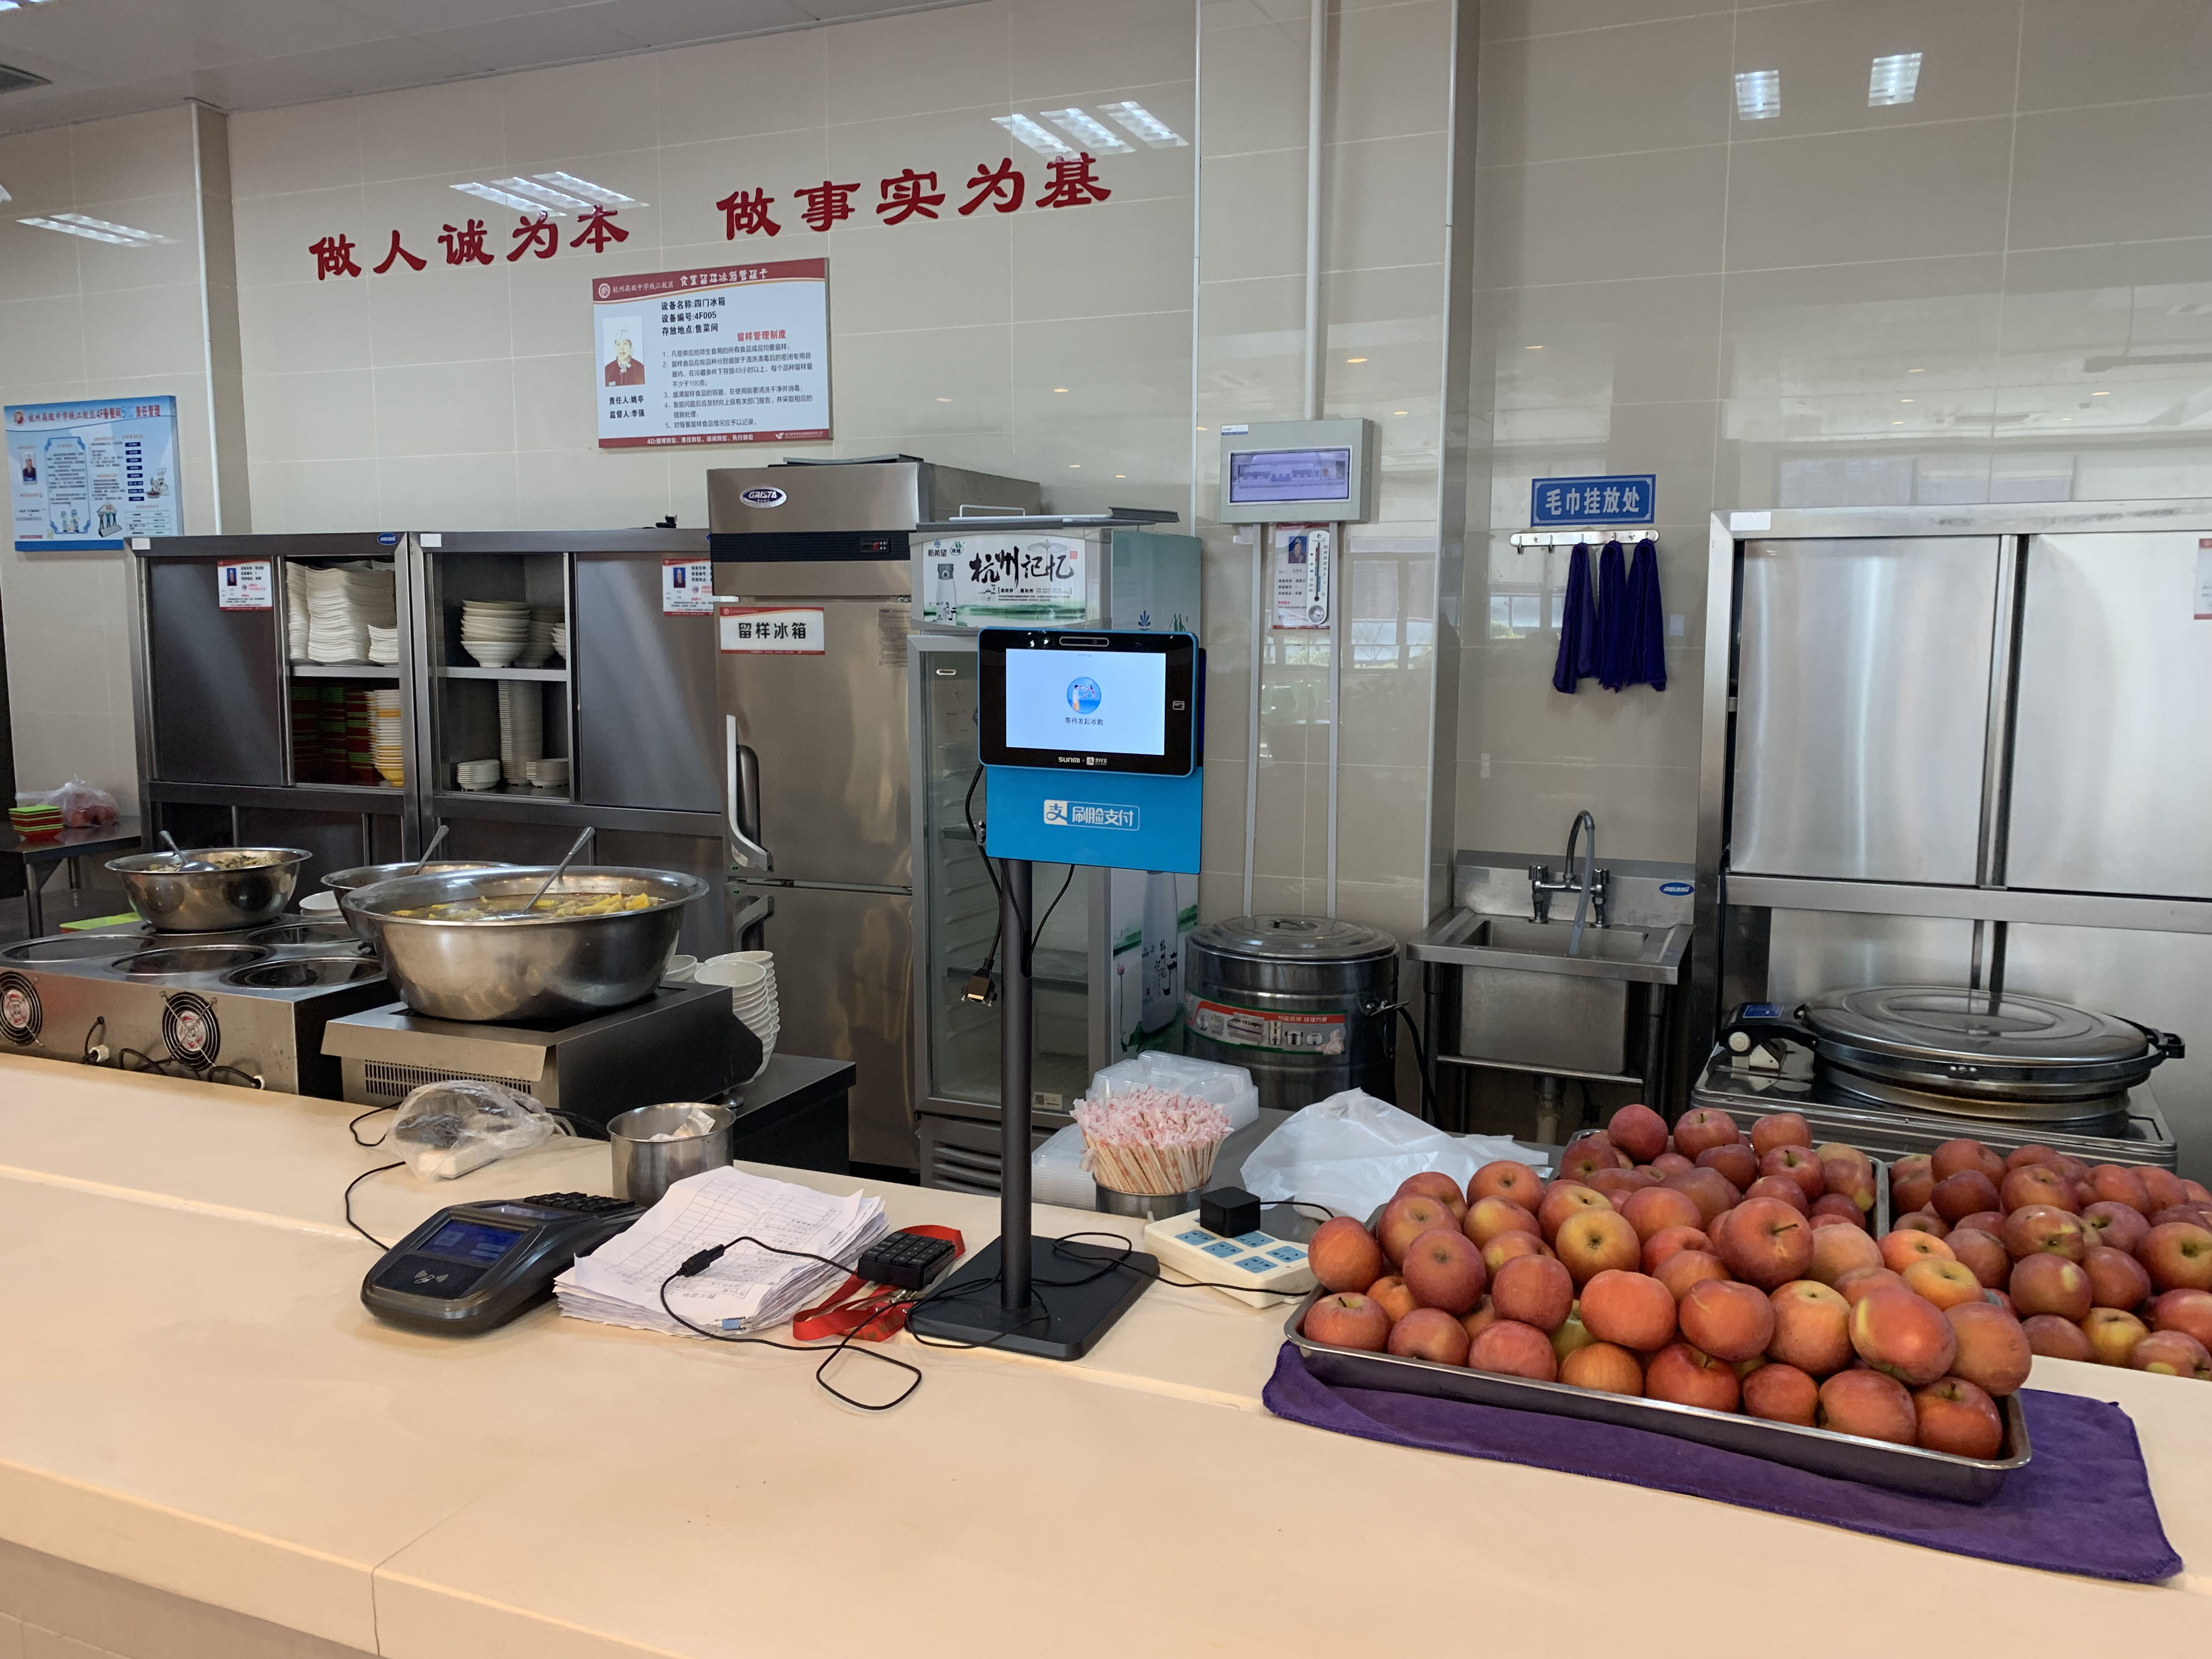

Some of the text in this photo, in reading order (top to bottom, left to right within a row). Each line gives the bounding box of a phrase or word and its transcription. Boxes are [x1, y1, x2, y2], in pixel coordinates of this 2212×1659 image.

[309, 151, 1112, 280] 做人诚为本 做事实为基
[680, 268, 768, 286] 食堂留样冰箱管理卡
[737, 329, 786, 341] 留样管理制度
[1545, 486, 1640, 515] 毛巾挂放处
[969, 546, 1074, 588] 杭州记忆
[738, 622, 807, 639] 留样冰箱
[1071, 806, 1134, 827] 刷脸支付
